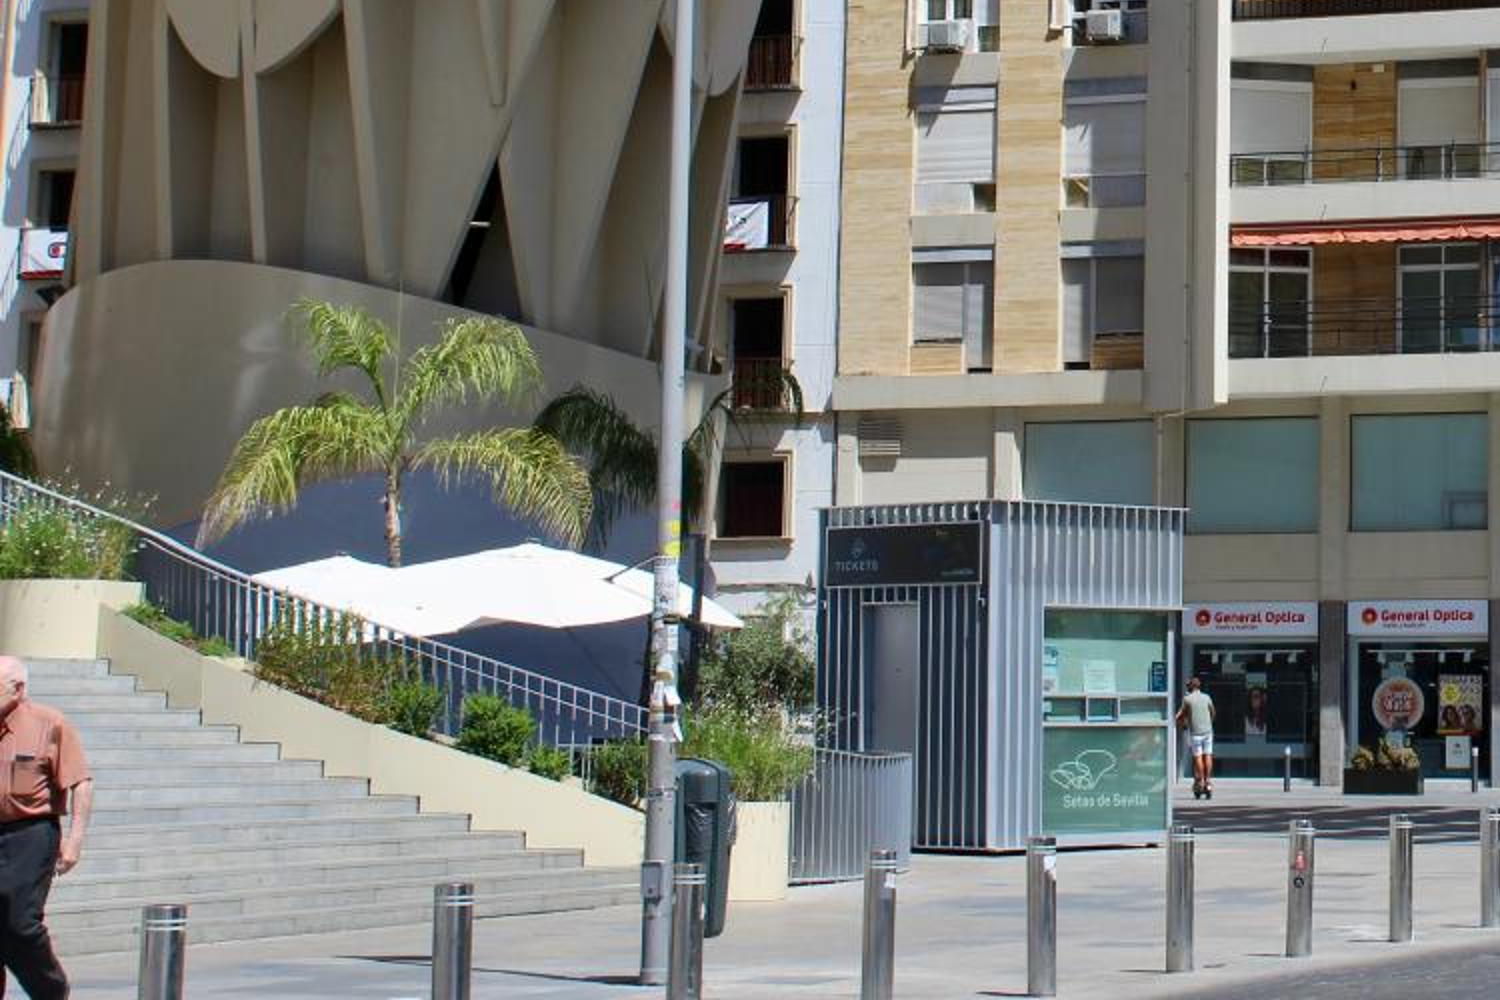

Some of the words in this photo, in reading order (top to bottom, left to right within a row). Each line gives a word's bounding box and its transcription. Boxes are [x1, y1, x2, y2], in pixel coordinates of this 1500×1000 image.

[1214, 611, 1262, 623] General
[1266, 611, 1305, 625] Optica
[1381, 609, 1429, 621] General
[1433, 609, 1473, 623] Optica
[1063, 795, 1094, 808] Setas
[1097, 794, 1111, 807] de
[1113, 793, 1148, 807] Sevilla
